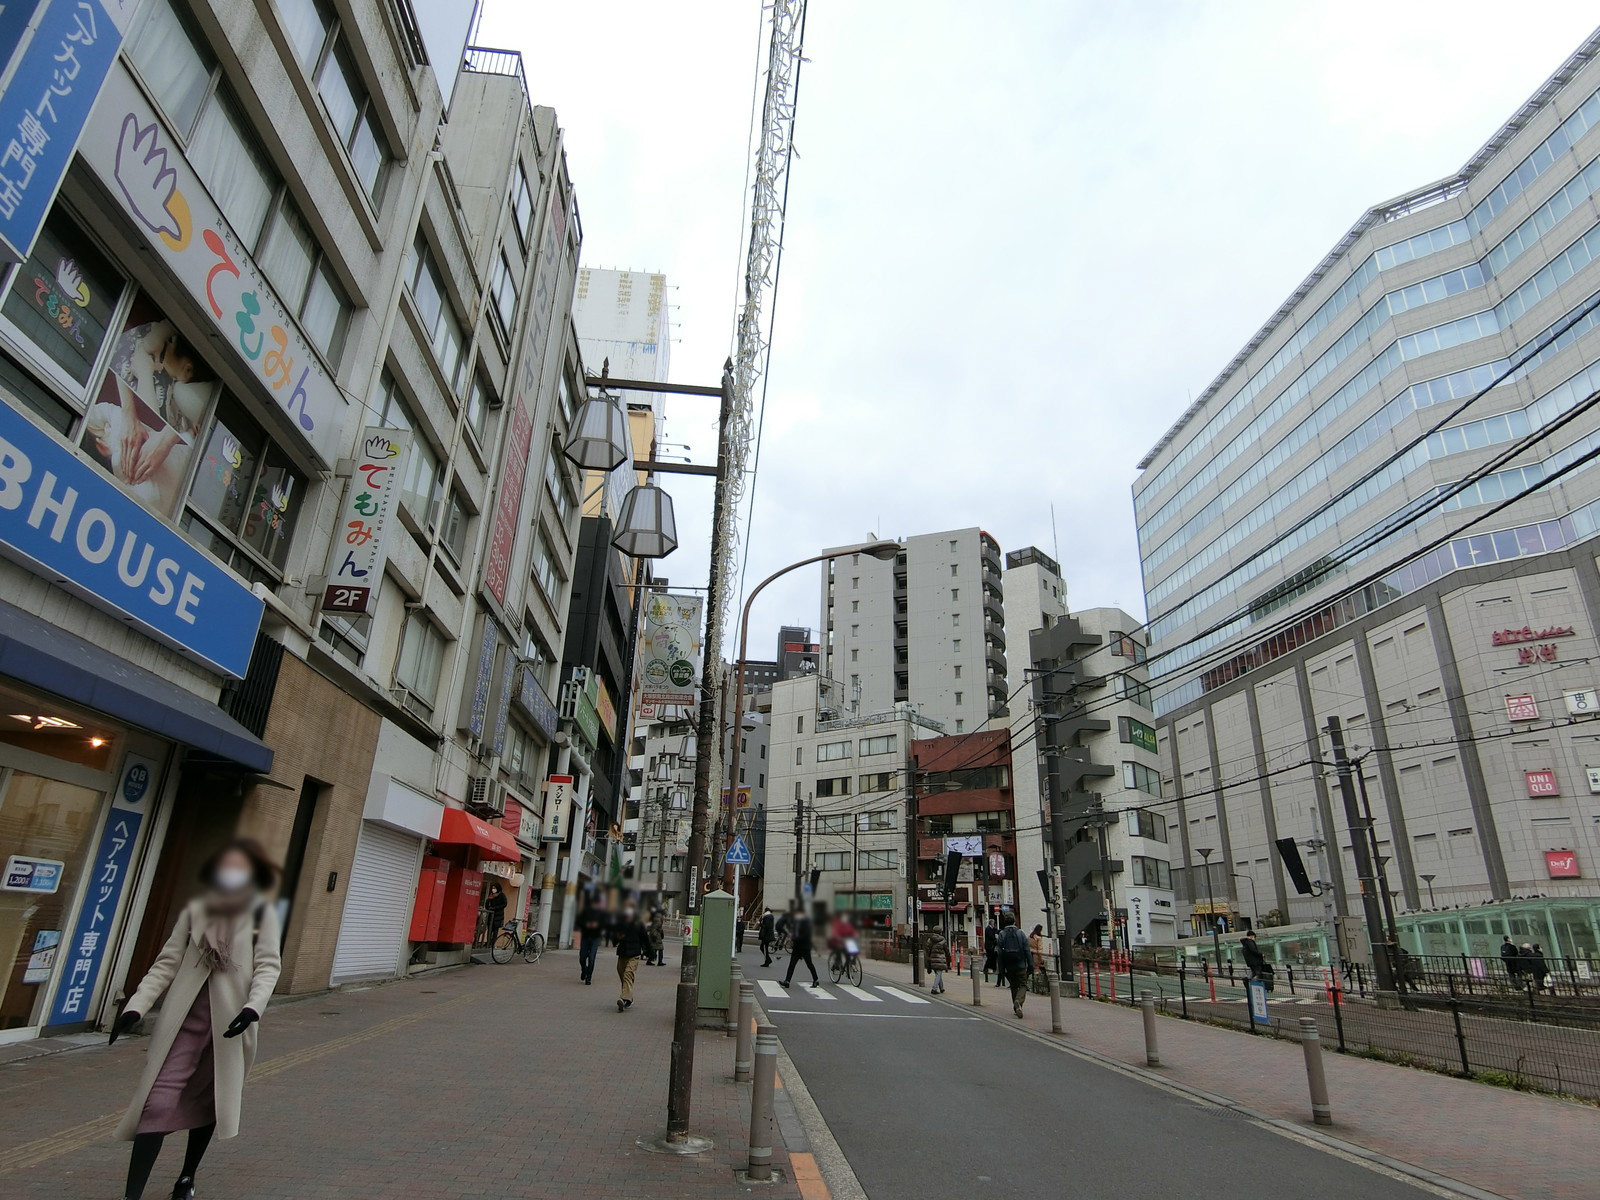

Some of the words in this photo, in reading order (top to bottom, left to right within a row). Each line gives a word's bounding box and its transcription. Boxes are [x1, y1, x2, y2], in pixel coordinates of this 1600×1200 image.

[33, 278, 85, 344] てもみん
[202, 228, 315, 432] てもみん
[216, 217, 291, 329] RELAXATION
[295, 335, 323, 378] SPACE
[338, 464, 388, 578] てもみん
[376, 466, 396, 532] RELAXATION
[367, 538, 380, 570] SPACE
[332, 589, 363, 607] 2F
[131, 768, 147, 781] QB
[1529, 775, 1549, 783] UNI
[1531, 783, 1553, 792] QLO
[62, 820, 129, 1014] ヘアカット専門店
